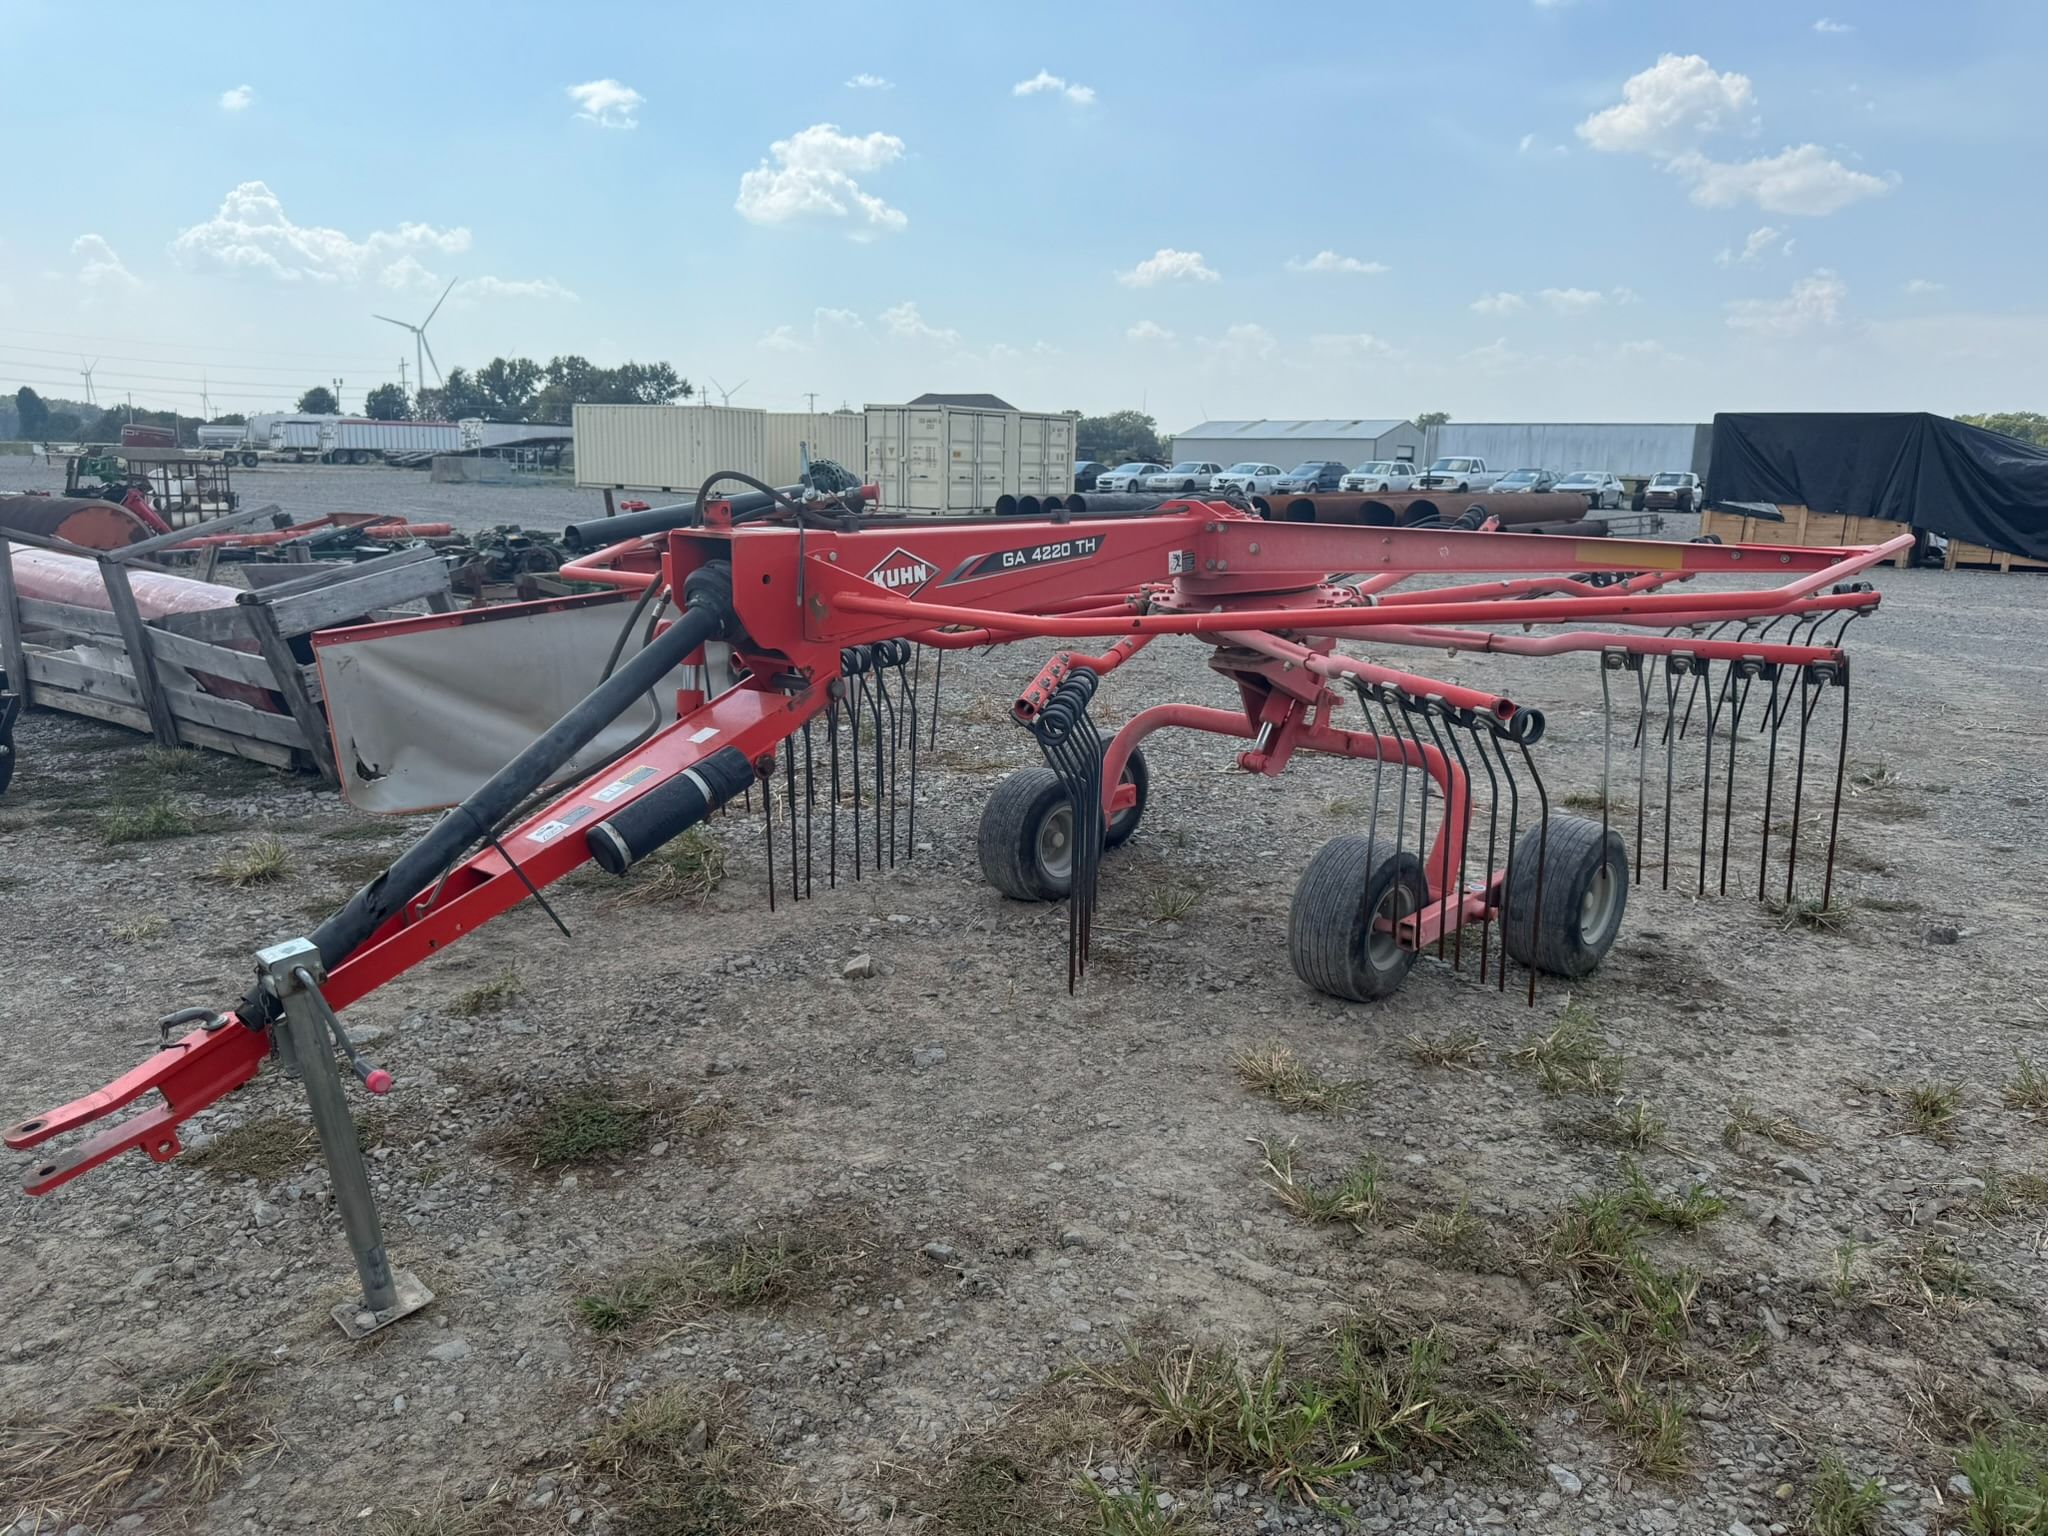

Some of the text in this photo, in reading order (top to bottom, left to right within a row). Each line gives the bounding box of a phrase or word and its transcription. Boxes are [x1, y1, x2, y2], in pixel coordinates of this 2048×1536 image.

[1003, 538, 1095, 567] GA 4220 TH
[873, 564, 927, 589] KUHN
